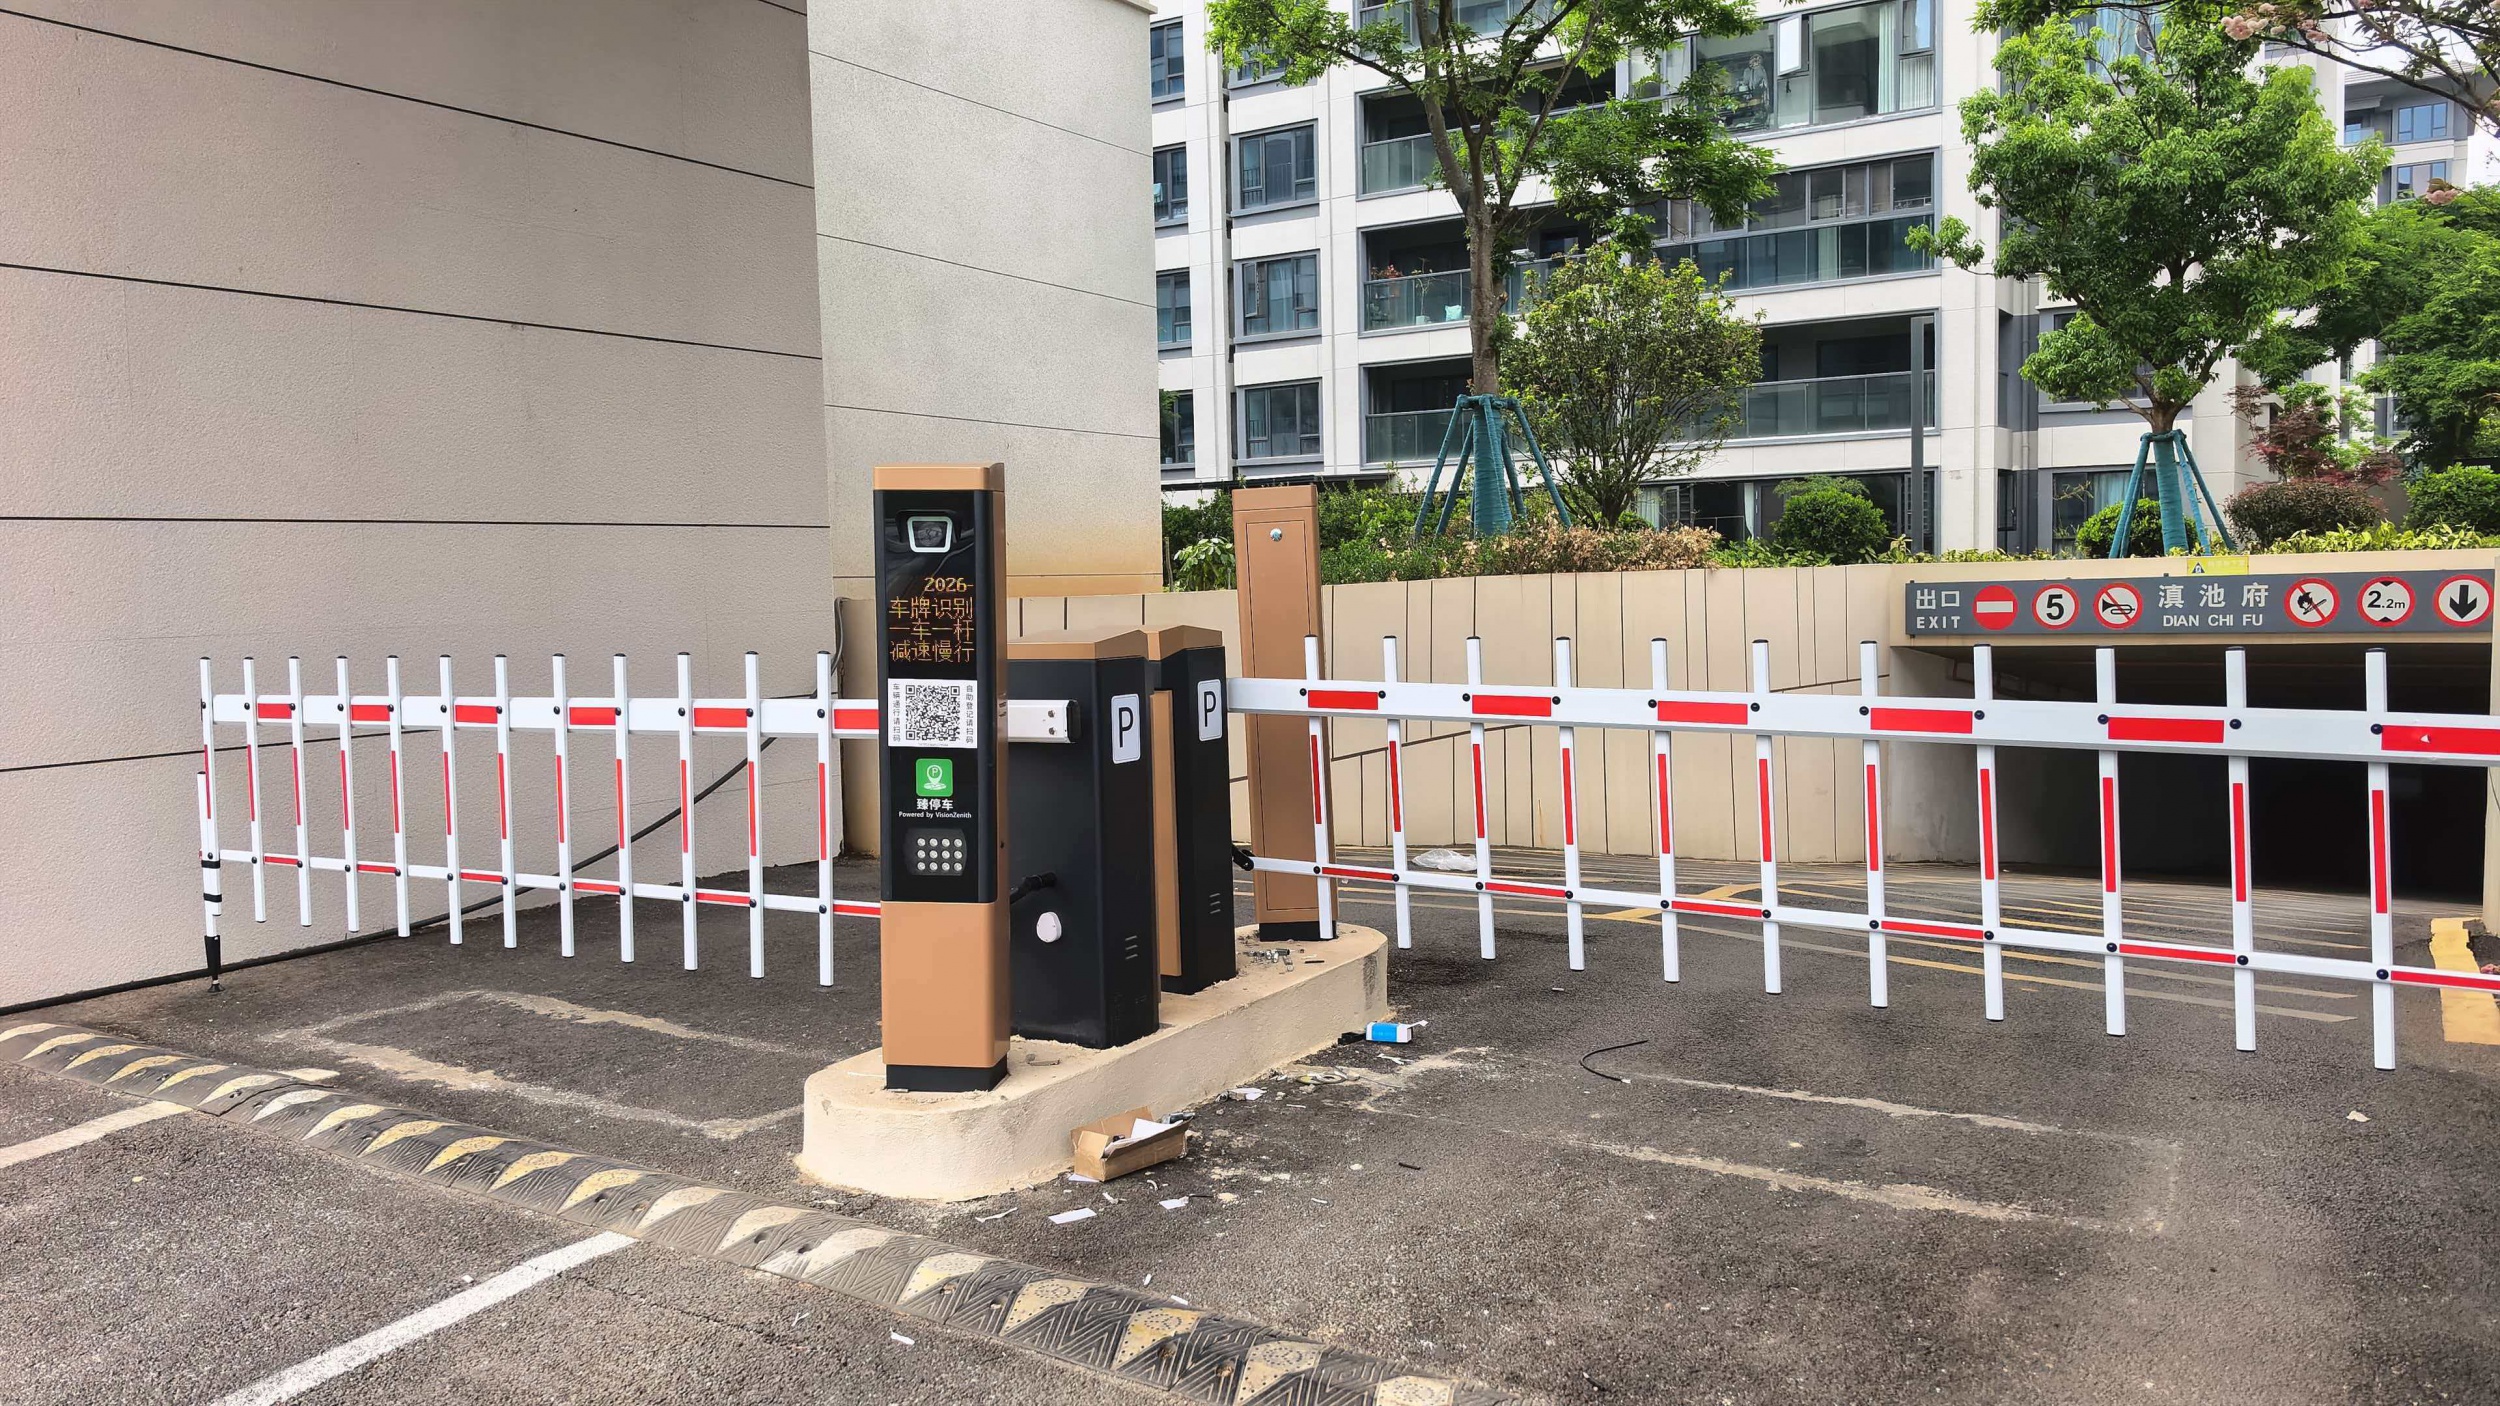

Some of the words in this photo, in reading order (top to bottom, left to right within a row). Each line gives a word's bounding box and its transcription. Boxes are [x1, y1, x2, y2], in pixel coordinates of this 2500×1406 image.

[1916, 588, 1960, 610] 出口
[2046, 594, 2065, 620] 5
[2158, 582, 2269, 609] 滇池府
[2367, 590, 2406, 609] 2.2m
[889, 596, 973, 619] 车牌识别
[889, 618, 975, 641] 一车一杆
[1916, 616, 1961, 629] EXIT
[2163, 614, 2200, 627] DIAN
[2207, 614, 2234, 626] CHI
[2242, 613, 2263, 626] FU
[889, 640, 975, 663] 减速慢行
[892, 683, 901, 742] 车辆通行请扫码
[966, 685, 974, 744] 自助登记请扫码
[1204, 691, 1217, 728] P
[1118, 706, 1134, 748] P
[916, 798, 954, 811] 臻停车
[926, 811, 934, 819] by
[935, 811, 972, 819] VisionZenith
